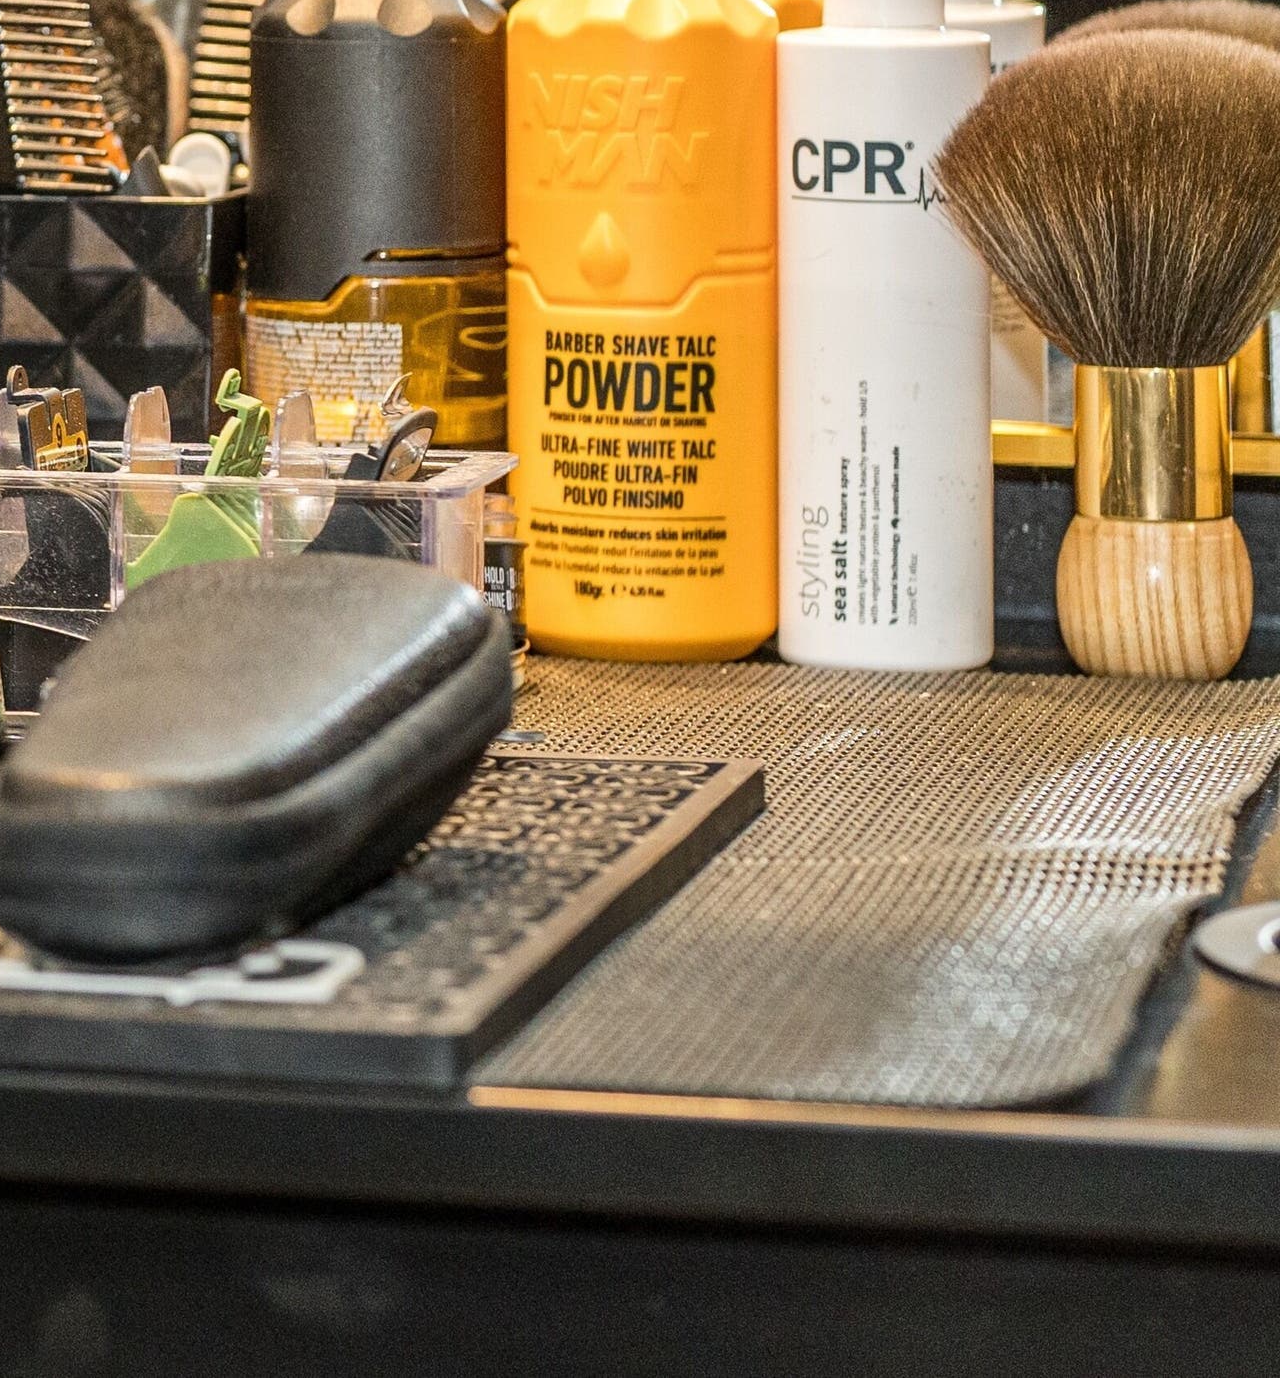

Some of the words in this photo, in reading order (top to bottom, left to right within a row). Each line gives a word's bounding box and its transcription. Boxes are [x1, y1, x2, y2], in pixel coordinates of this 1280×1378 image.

[528, 71, 686, 131] NISH
[538, 128, 710, 188] MAN
[546, 330, 604, 354] BARBER
[612, 335, 669, 357] SHAVE
[676, 335, 716, 357] TALC
[544, 356, 716, 413] POWDER
[578, 413, 592, 424] FOR
[595, 415, 619, 425] AFTER
[541, 433, 621, 458] ULTRA-FINE
[627, 440, 676, 459] WHITE
[681, 440, 716, 459] TALC
[891, 445, 900, 470] made
[553, 460, 608, 482] POUDRE
[615, 465, 698, 484] ULTRA-FIN
[840, 457, 851, 489] spray
[563, 486, 607, 507] POLVO
[613, 490, 684, 510] FINISIMO
[839, 492, 849, 534] texture
[562, 526, 604, 539] moisture
[609, 528, 651, 541] reduces
[656, 527, 678, 541] skin
[682, 528, 727, 542] irritation
[796, 503, 829, 619] styling
[831, 539, 848, 580] salt
[484, 566, 505, 584] HOLD
[483, 590, 506, 609] SHINE
[834, 587, 847, 622] sea
